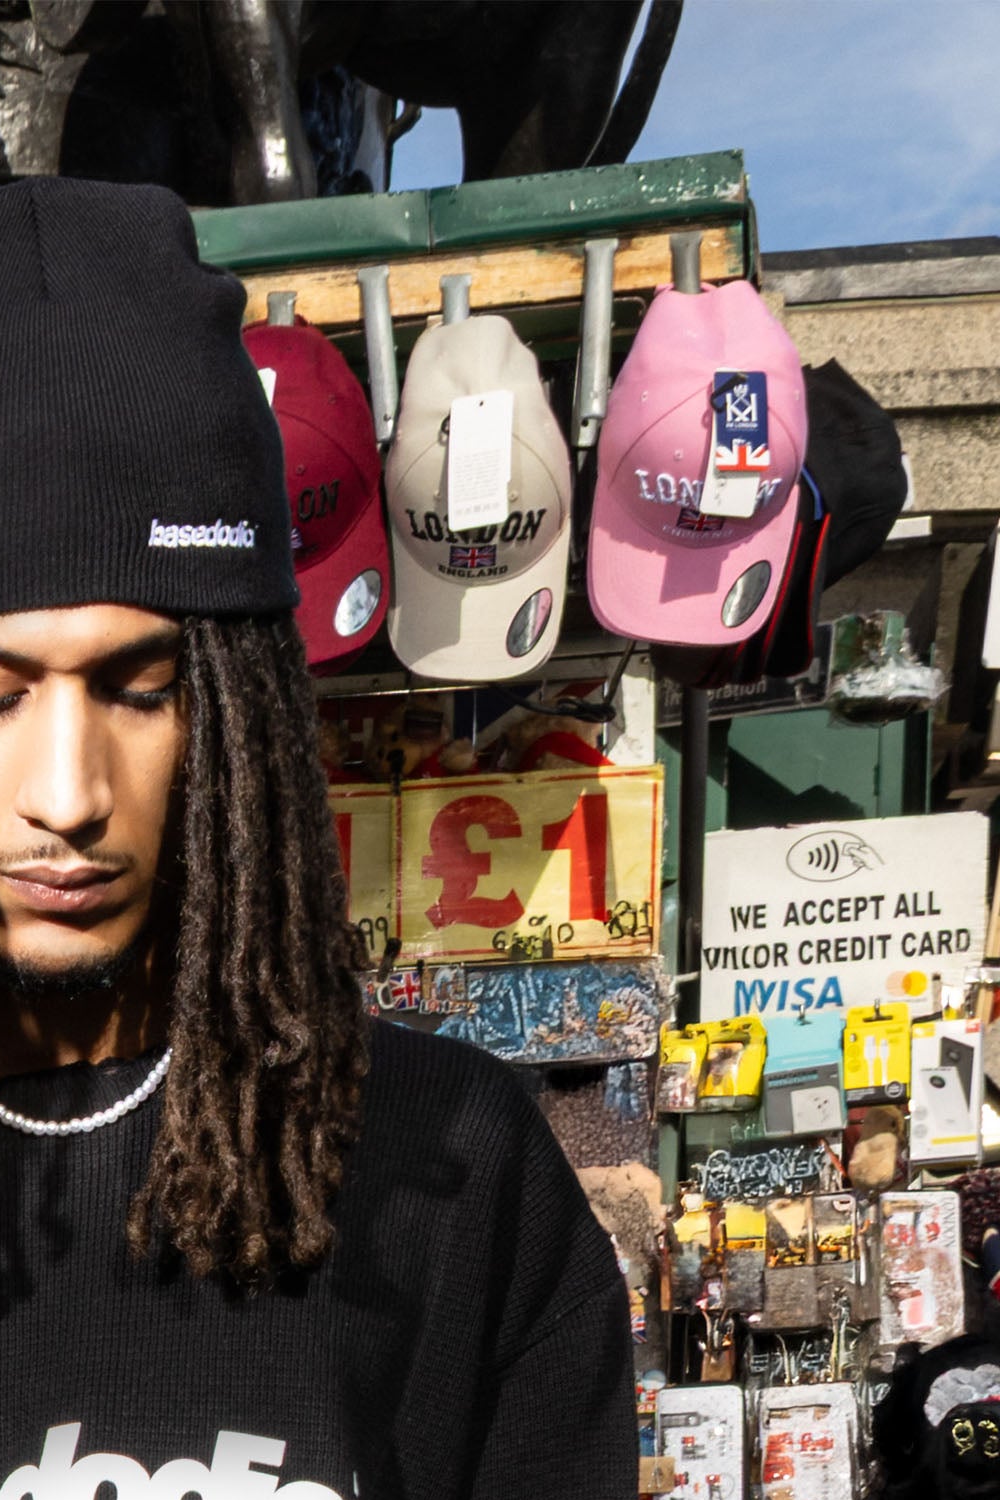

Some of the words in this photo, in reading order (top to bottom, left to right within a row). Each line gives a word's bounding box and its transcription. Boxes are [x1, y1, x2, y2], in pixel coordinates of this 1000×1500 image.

[438, 564, 508, 578] ENGLAND
[421, 787, 608, 931] £1
[783, 895, 885, 927] ACCEPT
[893, 890, 941, 918] ALL
[797, 934, 892, 965] CREDIT
[901, 928, 971, 957] CARD
